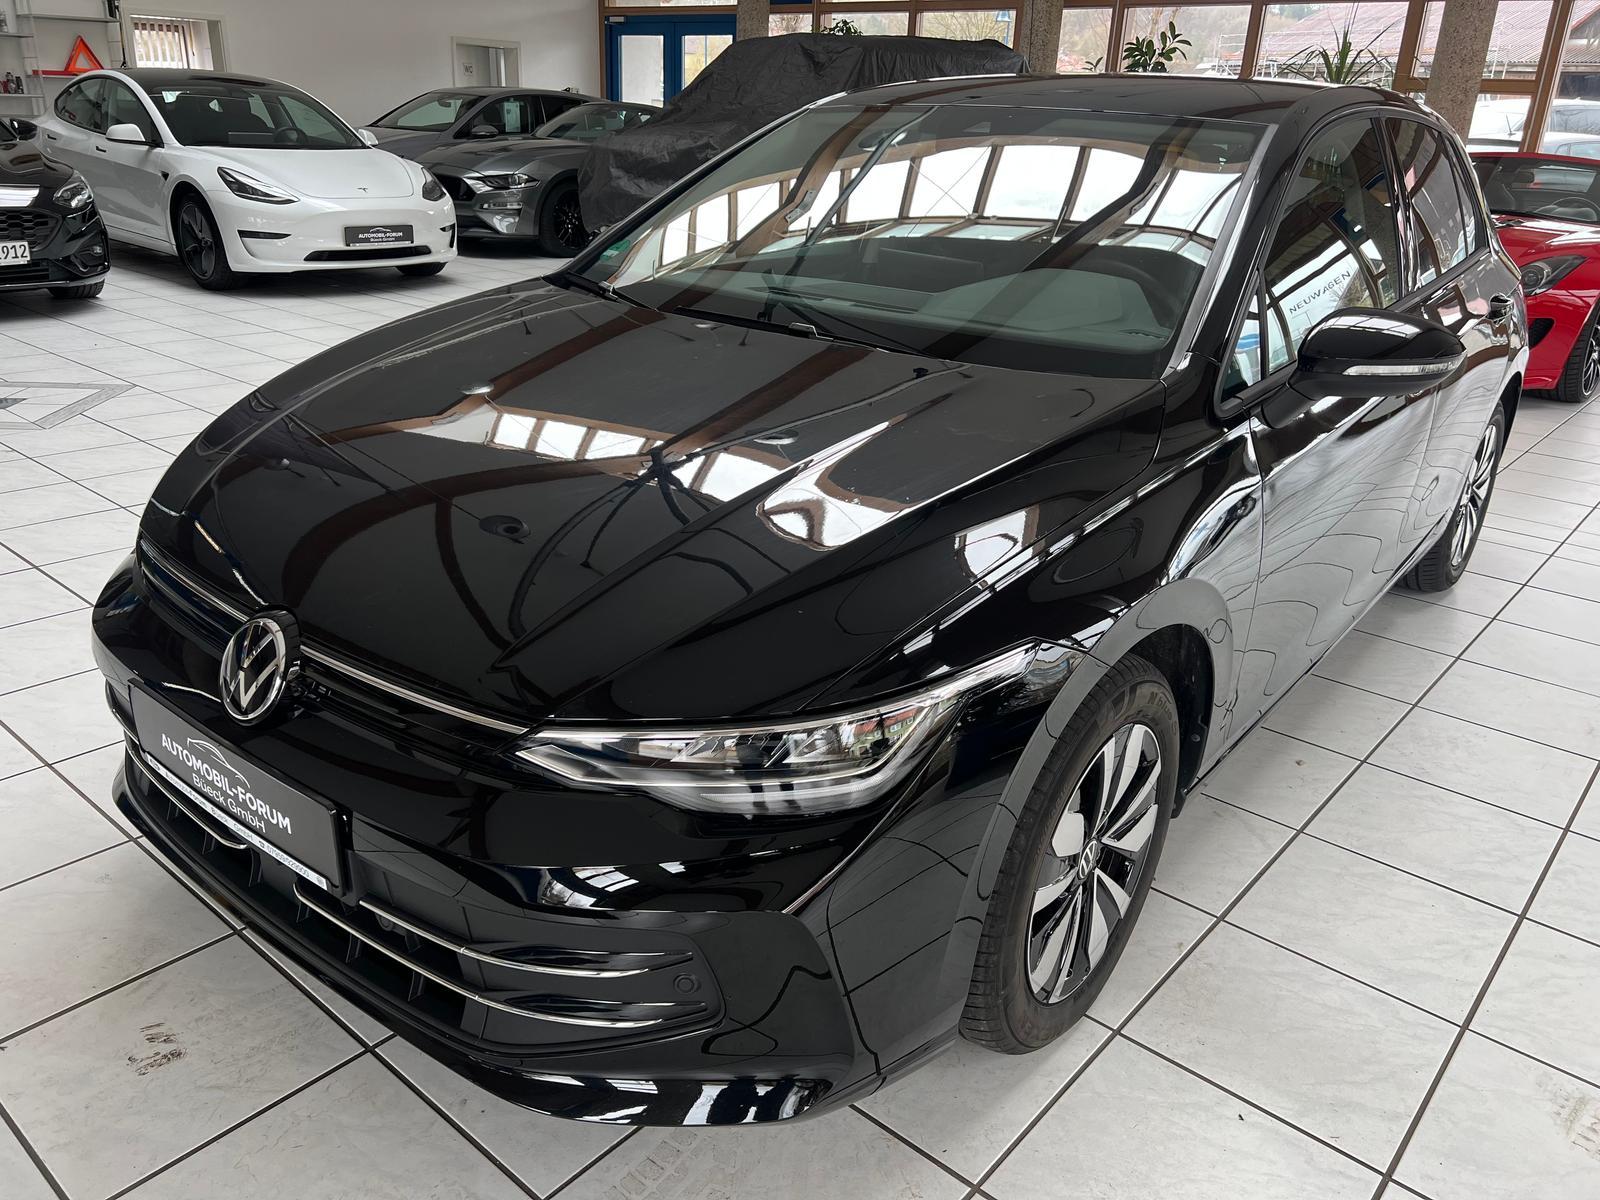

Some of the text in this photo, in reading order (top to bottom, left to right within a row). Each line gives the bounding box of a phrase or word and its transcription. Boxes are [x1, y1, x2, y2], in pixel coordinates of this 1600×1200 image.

[0, 244, 28, 260] 912
[1289, 270, 1351, 314] NEUWAGEN
[162, 733, 292, 835] AUTOMOBIL-FORUM
[192, 772, 227, 806] Büeck
[227, 798, 266, 834] GmbH
